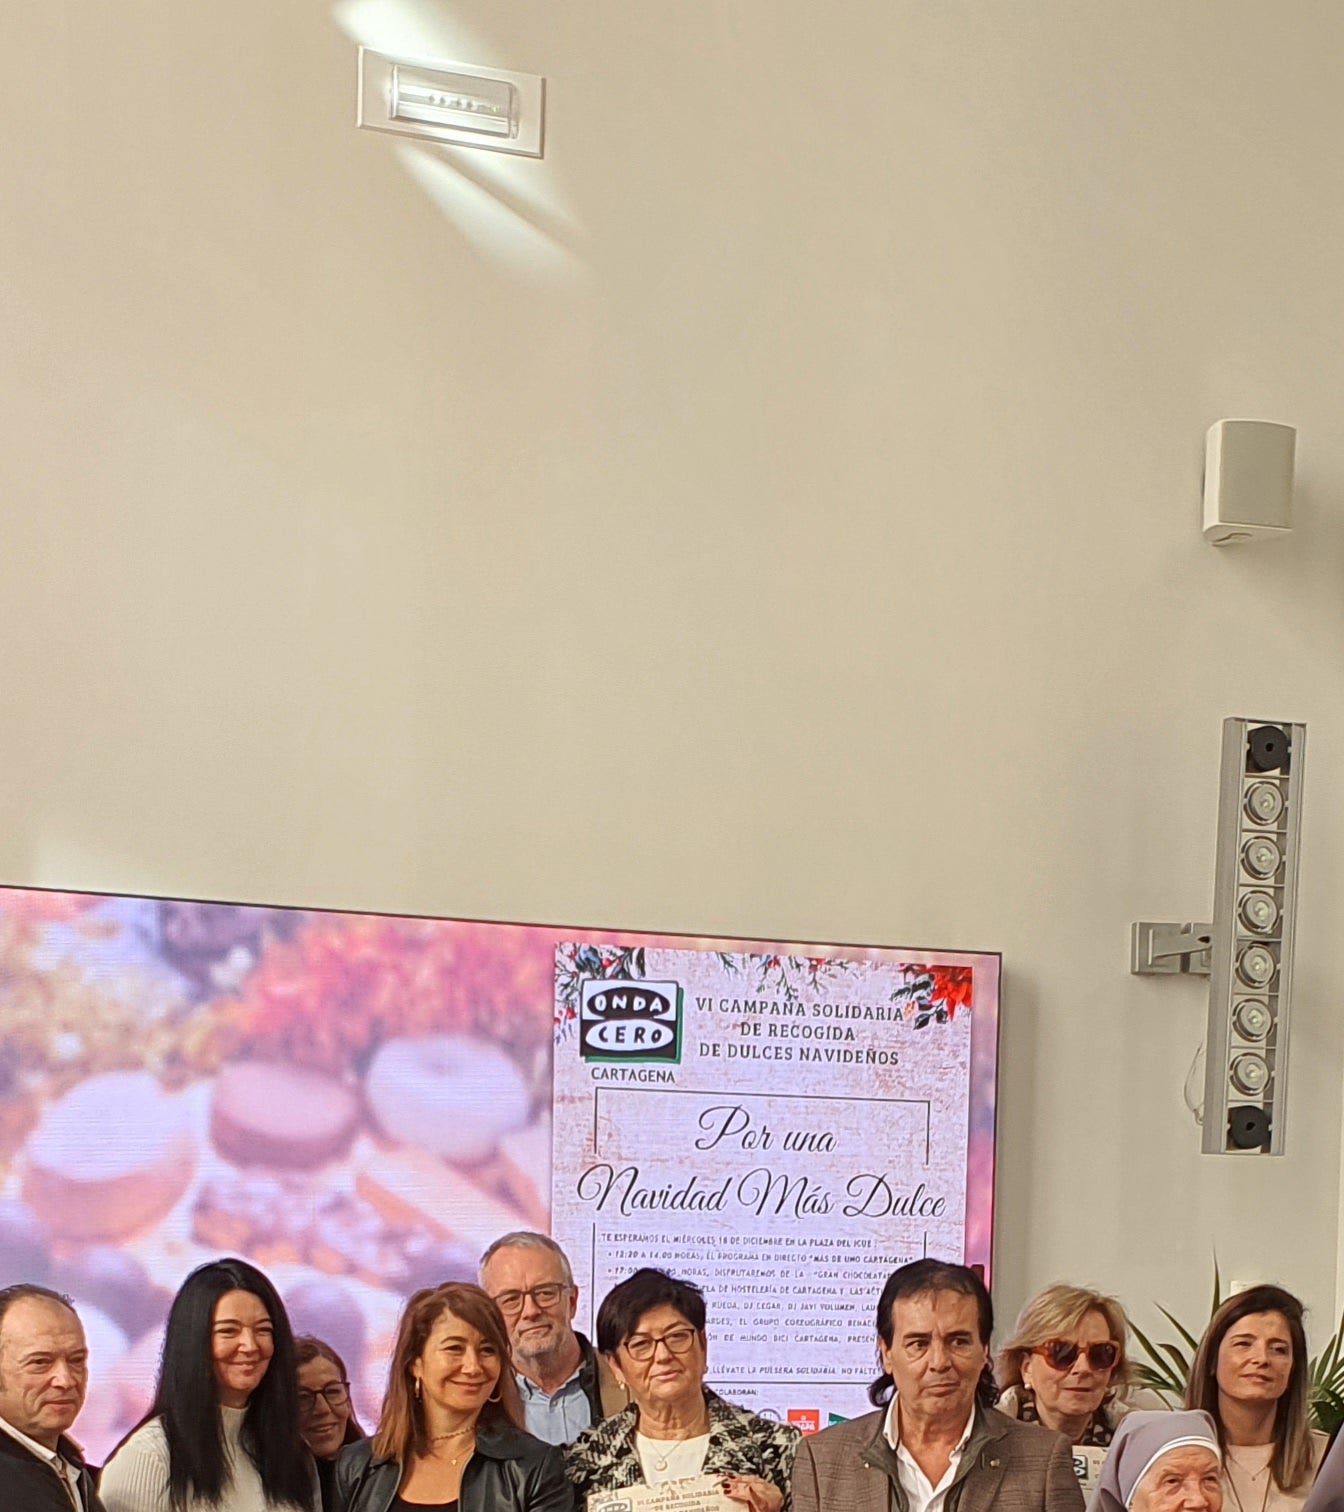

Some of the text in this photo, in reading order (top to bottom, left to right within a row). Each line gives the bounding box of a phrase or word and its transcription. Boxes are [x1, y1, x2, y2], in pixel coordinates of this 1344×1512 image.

[595, 994, 662, 1012] ONDA
[696, 998, 712, 1011] VI
[813, 1004, 904, 1021] SOLIDARIA
[599, 1026, 662, 1043] CERO
[740, 1022, 761, 1036] DE
[699, 1043, 899, 1065] DE DULCES NAVIDEÑOS
[591, 1067, 675, 1083] CARTAGENA
[694, 1104, 837, 1152] Por una
[577, 1163, 946, 1219] Navidad Más Dulce
[615, 1234, 658, 1243] ESPERAMOS
[810, 1239, 833, 1247] PLAZA
